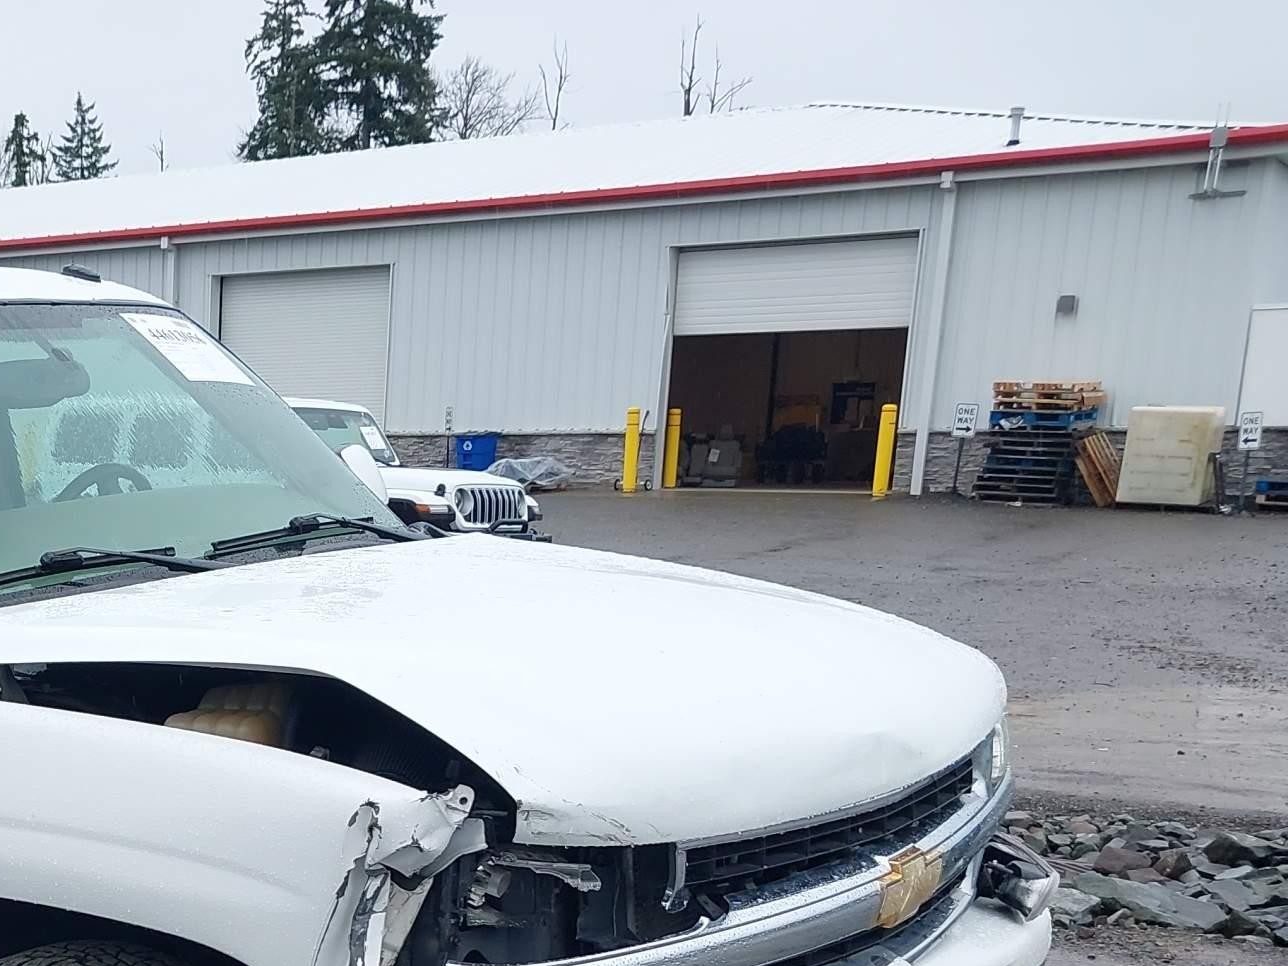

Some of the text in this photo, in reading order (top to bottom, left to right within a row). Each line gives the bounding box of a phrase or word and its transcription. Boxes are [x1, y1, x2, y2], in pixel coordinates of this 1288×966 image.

[958, 407, 976, 416] ONE
[957, 416, 975, 425] WAY
[1243, 416, 1260, 426] ONE
